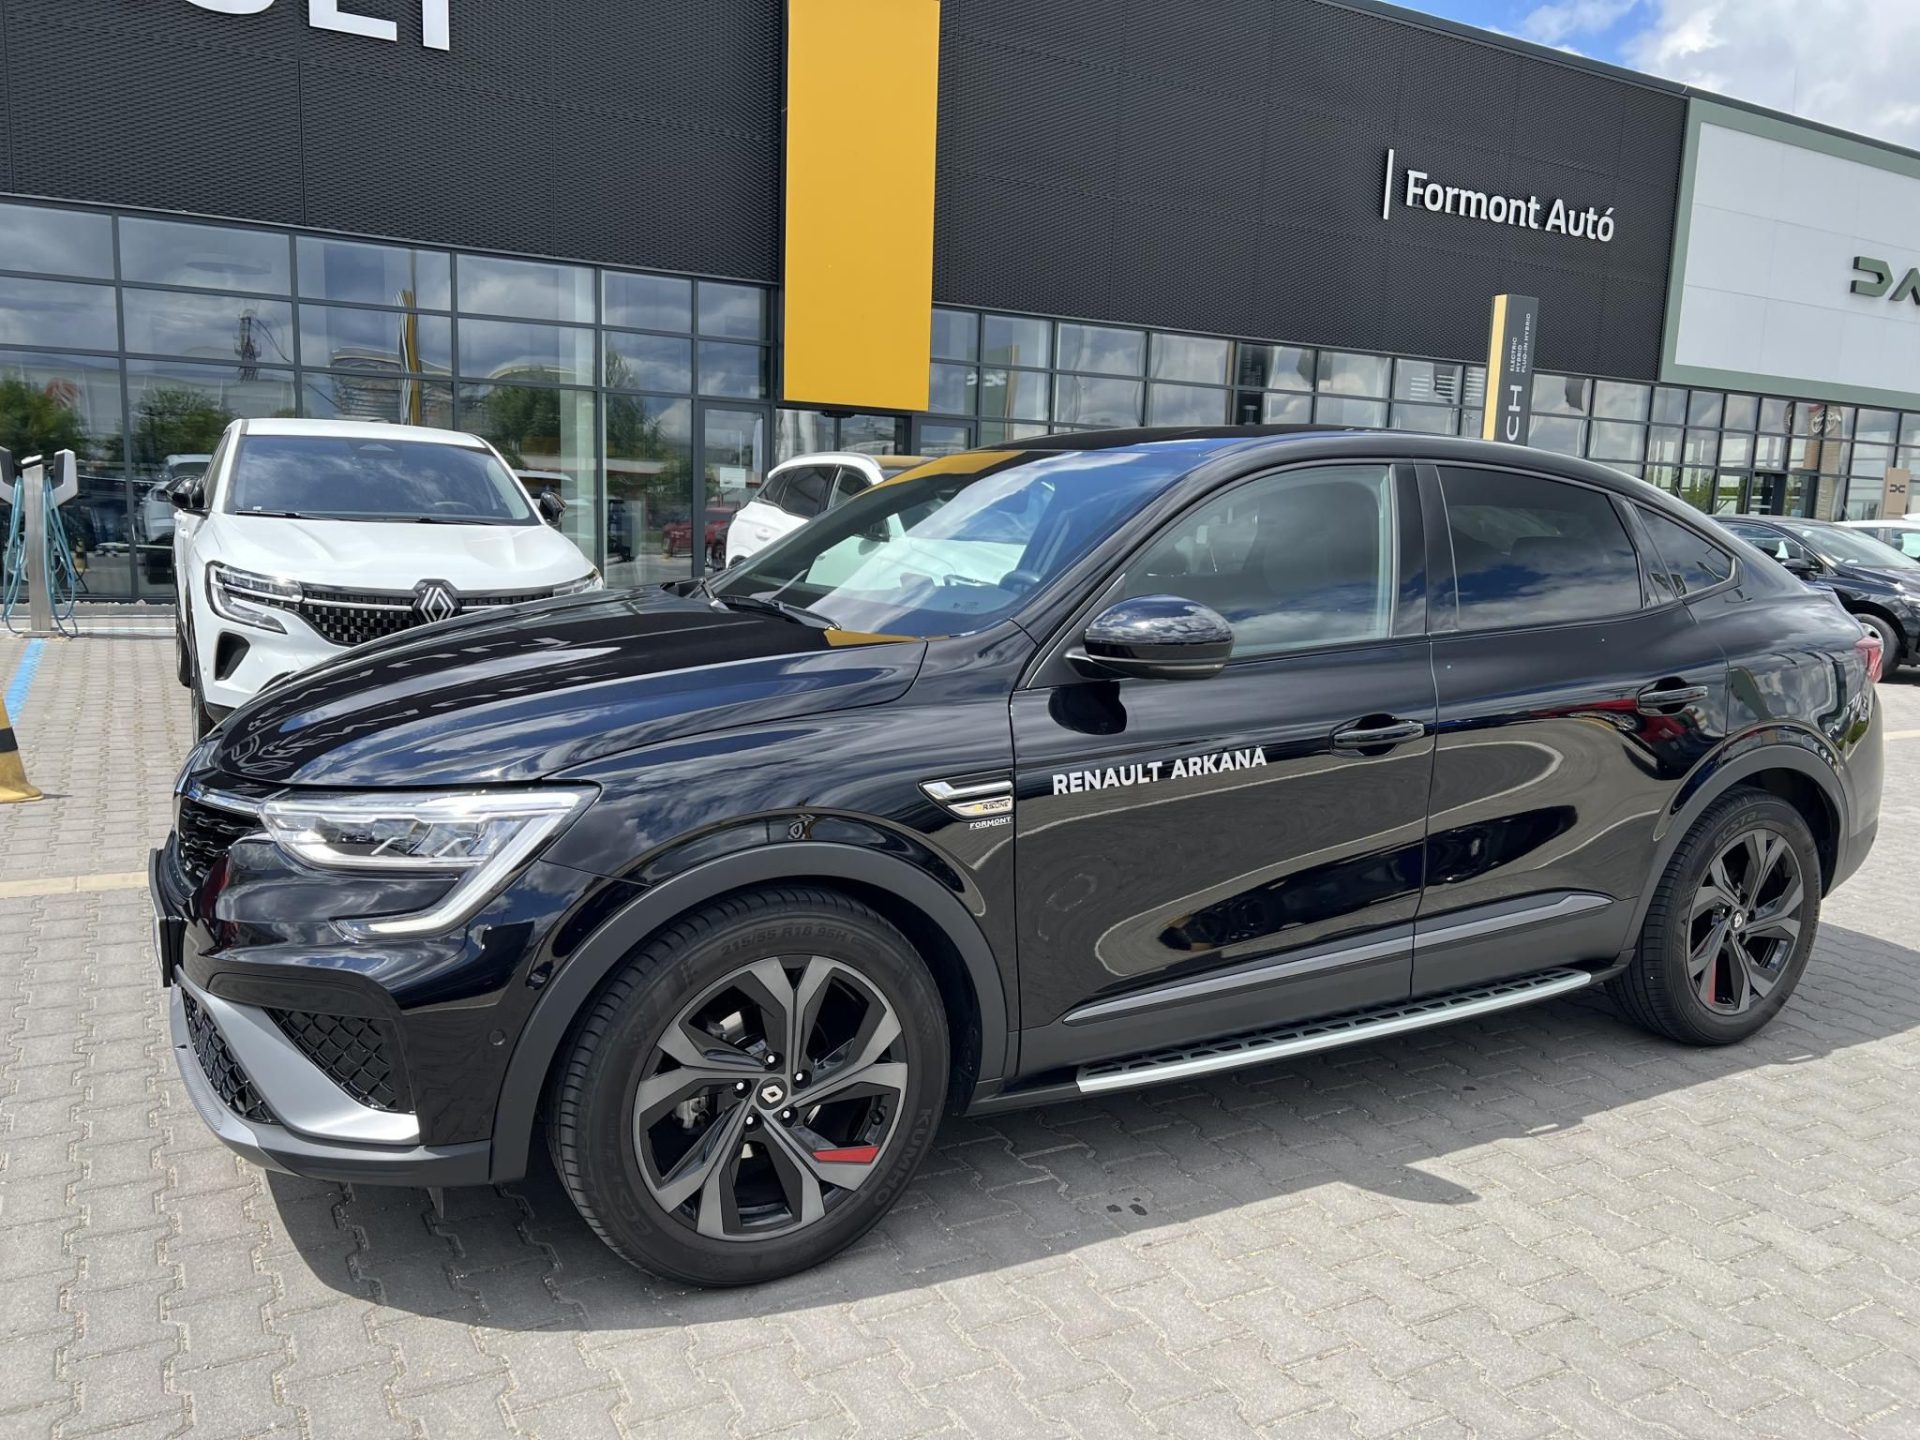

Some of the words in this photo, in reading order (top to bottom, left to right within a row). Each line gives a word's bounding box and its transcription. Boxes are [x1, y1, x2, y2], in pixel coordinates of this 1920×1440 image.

[1406, 169, 1541, 229] Formont
[1545, 198, 1615, 242] Autó
[1509, 336, 1518, 372] ELECTRIC
[1515, 344, 1523, 373] HYBRID
[1052, 760, 1163, 796] RENAULT
[1170, 747, 1268, 780] ARKANA
[970, 816, 1012, 829] FORMONT
[873, 1107, 933, 1206] KUMHO
